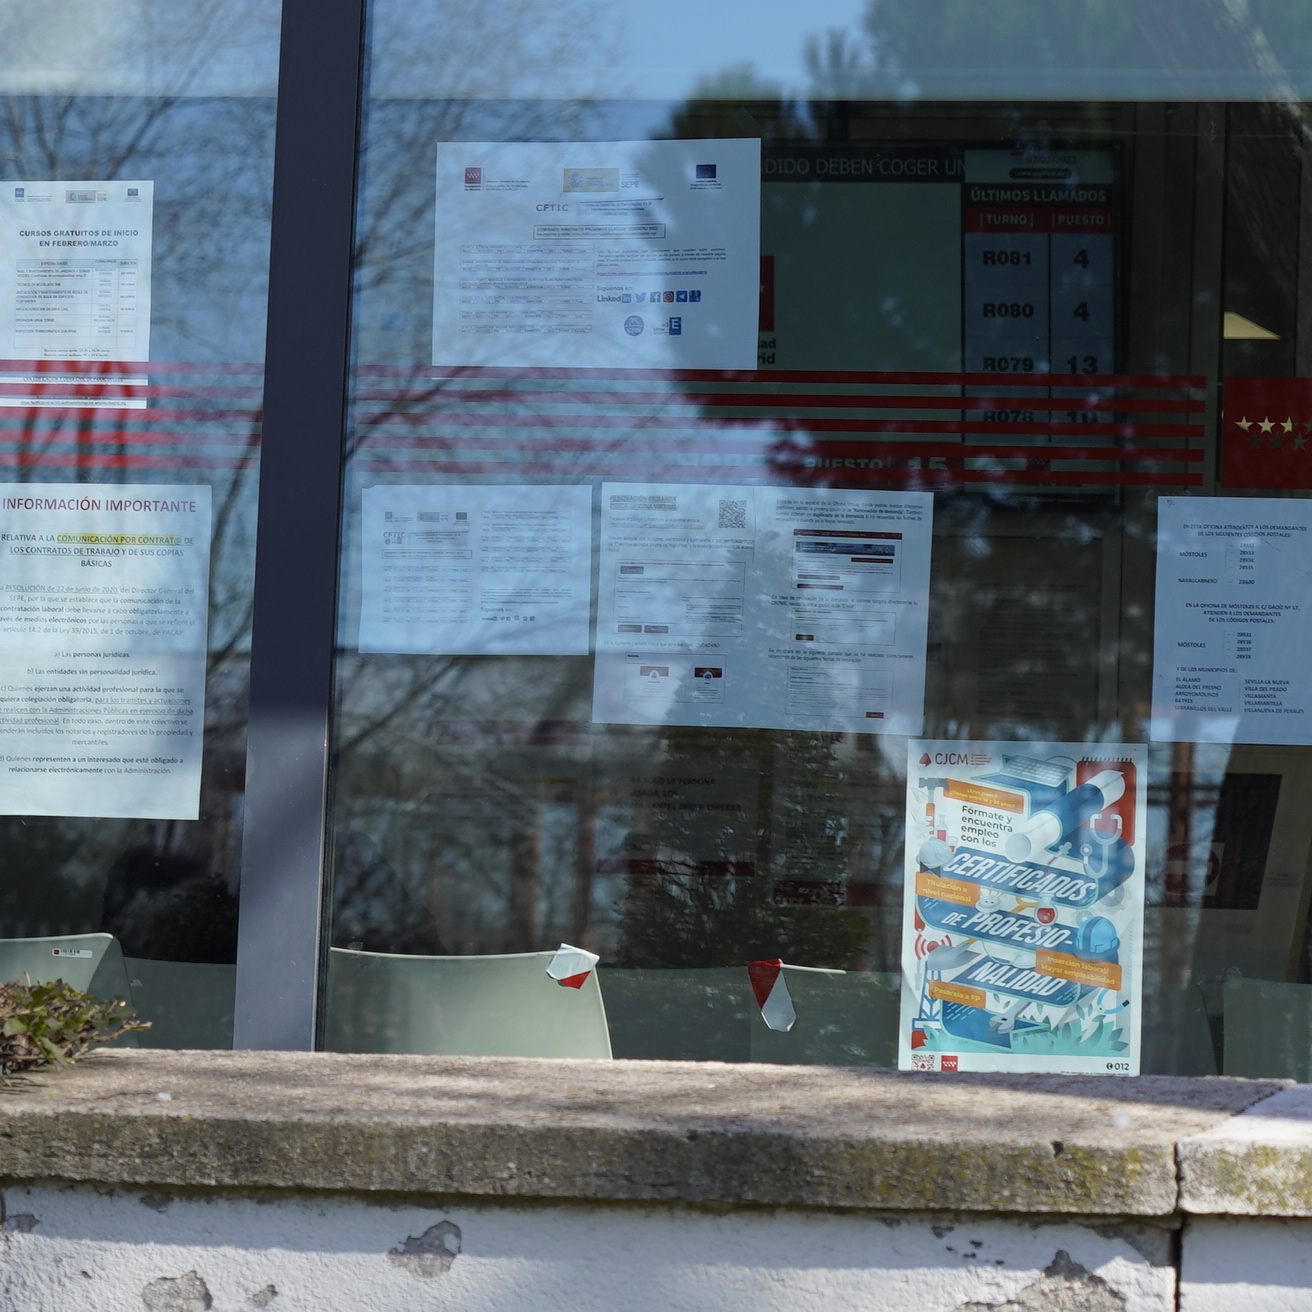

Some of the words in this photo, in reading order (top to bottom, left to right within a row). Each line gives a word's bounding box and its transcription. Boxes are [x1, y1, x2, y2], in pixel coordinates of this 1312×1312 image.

[816, 159, 873, 174] DEBEN
[879, 159, 939, 175] COGER
[971, 187, 1030, 201] ÚLTIMOS
[1034, 191, 1106, 201] LLAMADOS
[986, 215, 1027, 224] TURNO
[1058, 215, 1104, 224] PUESTO
[983, 251, 1031, 265] R081
[1074, 249, 1089, 268] 4
[983, 304, 1033, 318] R080
[1074, 303, 1089, 321] 4
[983, 357, 1034, 371] R079
[1067, 356, 1097, 374] 13
[2, 497, 100, 511] INFORMACIÓN
[106, 500, 196, 513] IMPORTANTE
[57, 534, 118, 543] COMUNICACIÓN
[138, 537, 182, 545] CONTRAT@
[26, 547, 72, 555] CONTRATOS
[86, 548, 119, 556] TRABAJO
[81, 559, 112, 567] BÁSICAS
[935, 753, 968, 765] CJCM
[962, 805, 1004, 821] Fórmate
[1007, 816, 1013, 824] y
[962, 816, 1013, 832] encuentra
[961, 825, 999, 839] empleo
[961, 833, 979, 844] con
[982, 837, 996, 847] los
[943, 853, 1095, 901] CERTIFICADOS
[926, 878, 961, 893] Titulación
[922, 887, 942, 898] nivel
[943, 890, 971, 903] nacional
[941, 912, 966, 926] DE
[962, 911, 1073, 948] PROFESIO-
[1047, 955, 1080, 969] Inserción
[967, 961, 1066, 997] NALIDAD
[1041, 964, 1063, 977] Mayor
[1064, 969, 1115, 985] empleabilidad
[934, 987, 964, 999] Pasarela
[971, 993, 980, 1002] FP
